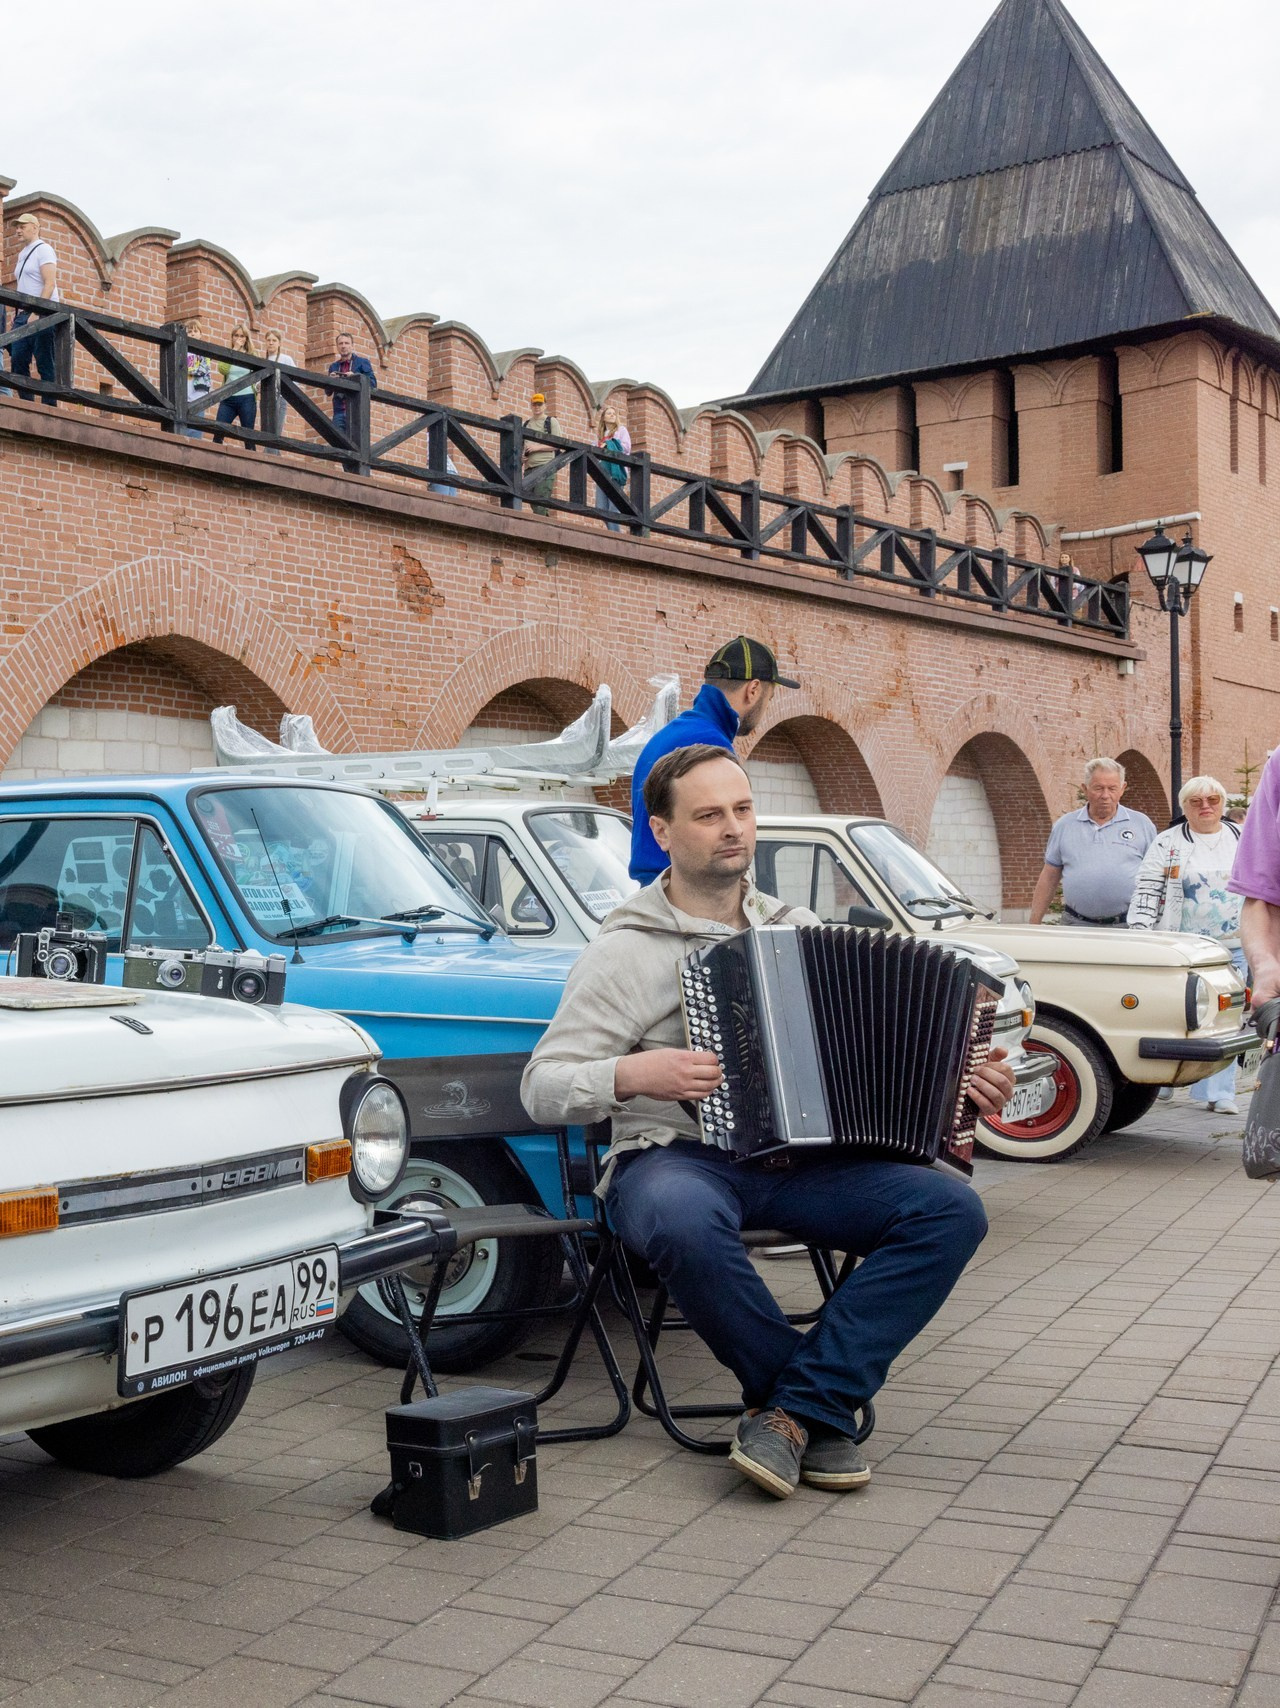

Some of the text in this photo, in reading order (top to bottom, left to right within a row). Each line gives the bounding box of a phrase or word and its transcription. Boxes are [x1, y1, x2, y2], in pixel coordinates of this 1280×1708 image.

[241, 888, 280, 898] ВТОКЛУБ
[297, 1258, 327, 1304] 99
[292, 1302, 316, 1323] RUS
[150, 1328, 326, 1390] АВИЛОН официальный дилер Volkswagen 730-44-47
